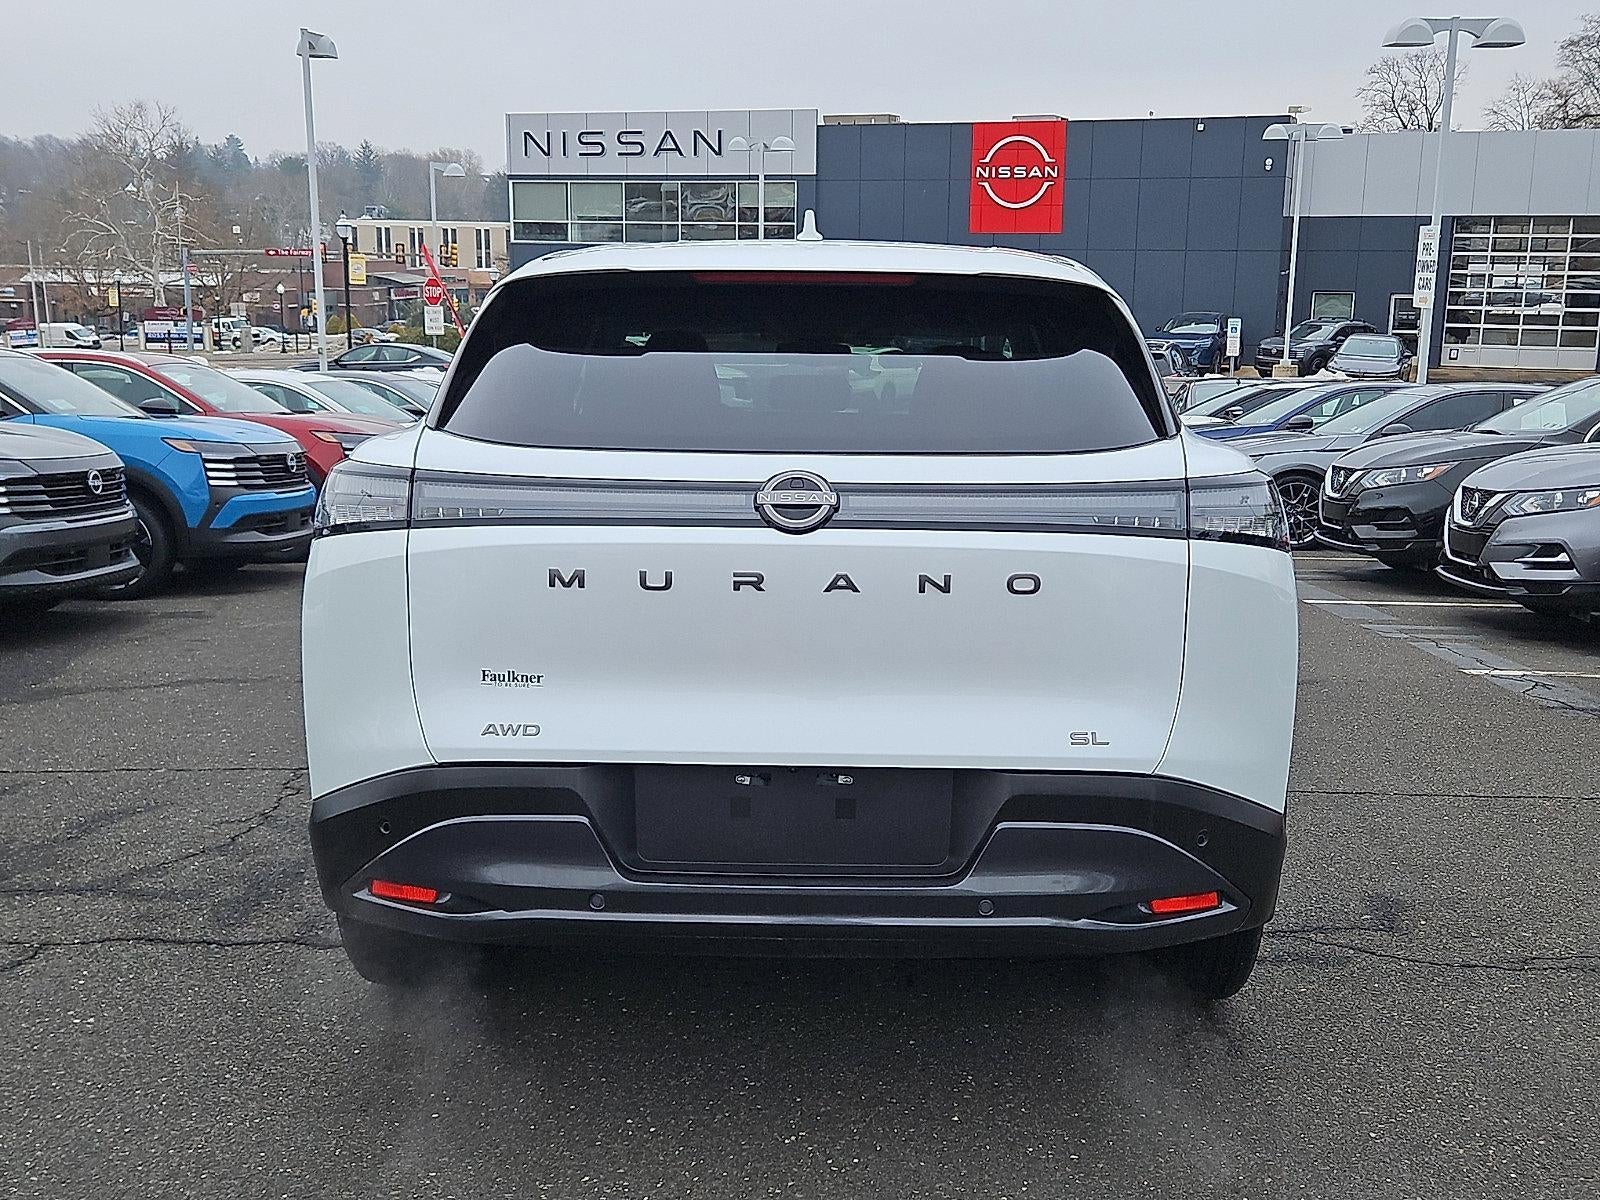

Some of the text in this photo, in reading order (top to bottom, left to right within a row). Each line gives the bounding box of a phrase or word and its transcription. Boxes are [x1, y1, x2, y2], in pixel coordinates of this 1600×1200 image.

[523, 129, 723, 157] NISSAN
[976, 166, 1058, 178] NISSAN
[1418, 277, 1432, 291] CARS
[425, 286, 442, 297] STOP
[759, 493, 835, 503] NISSAN
[547, 568, 1042, 595] MURANO
[481, 669, 544, 683] Faulkner
[481, 723, 541, 737] AWD
[1069, 731, 1110, 746] SL
